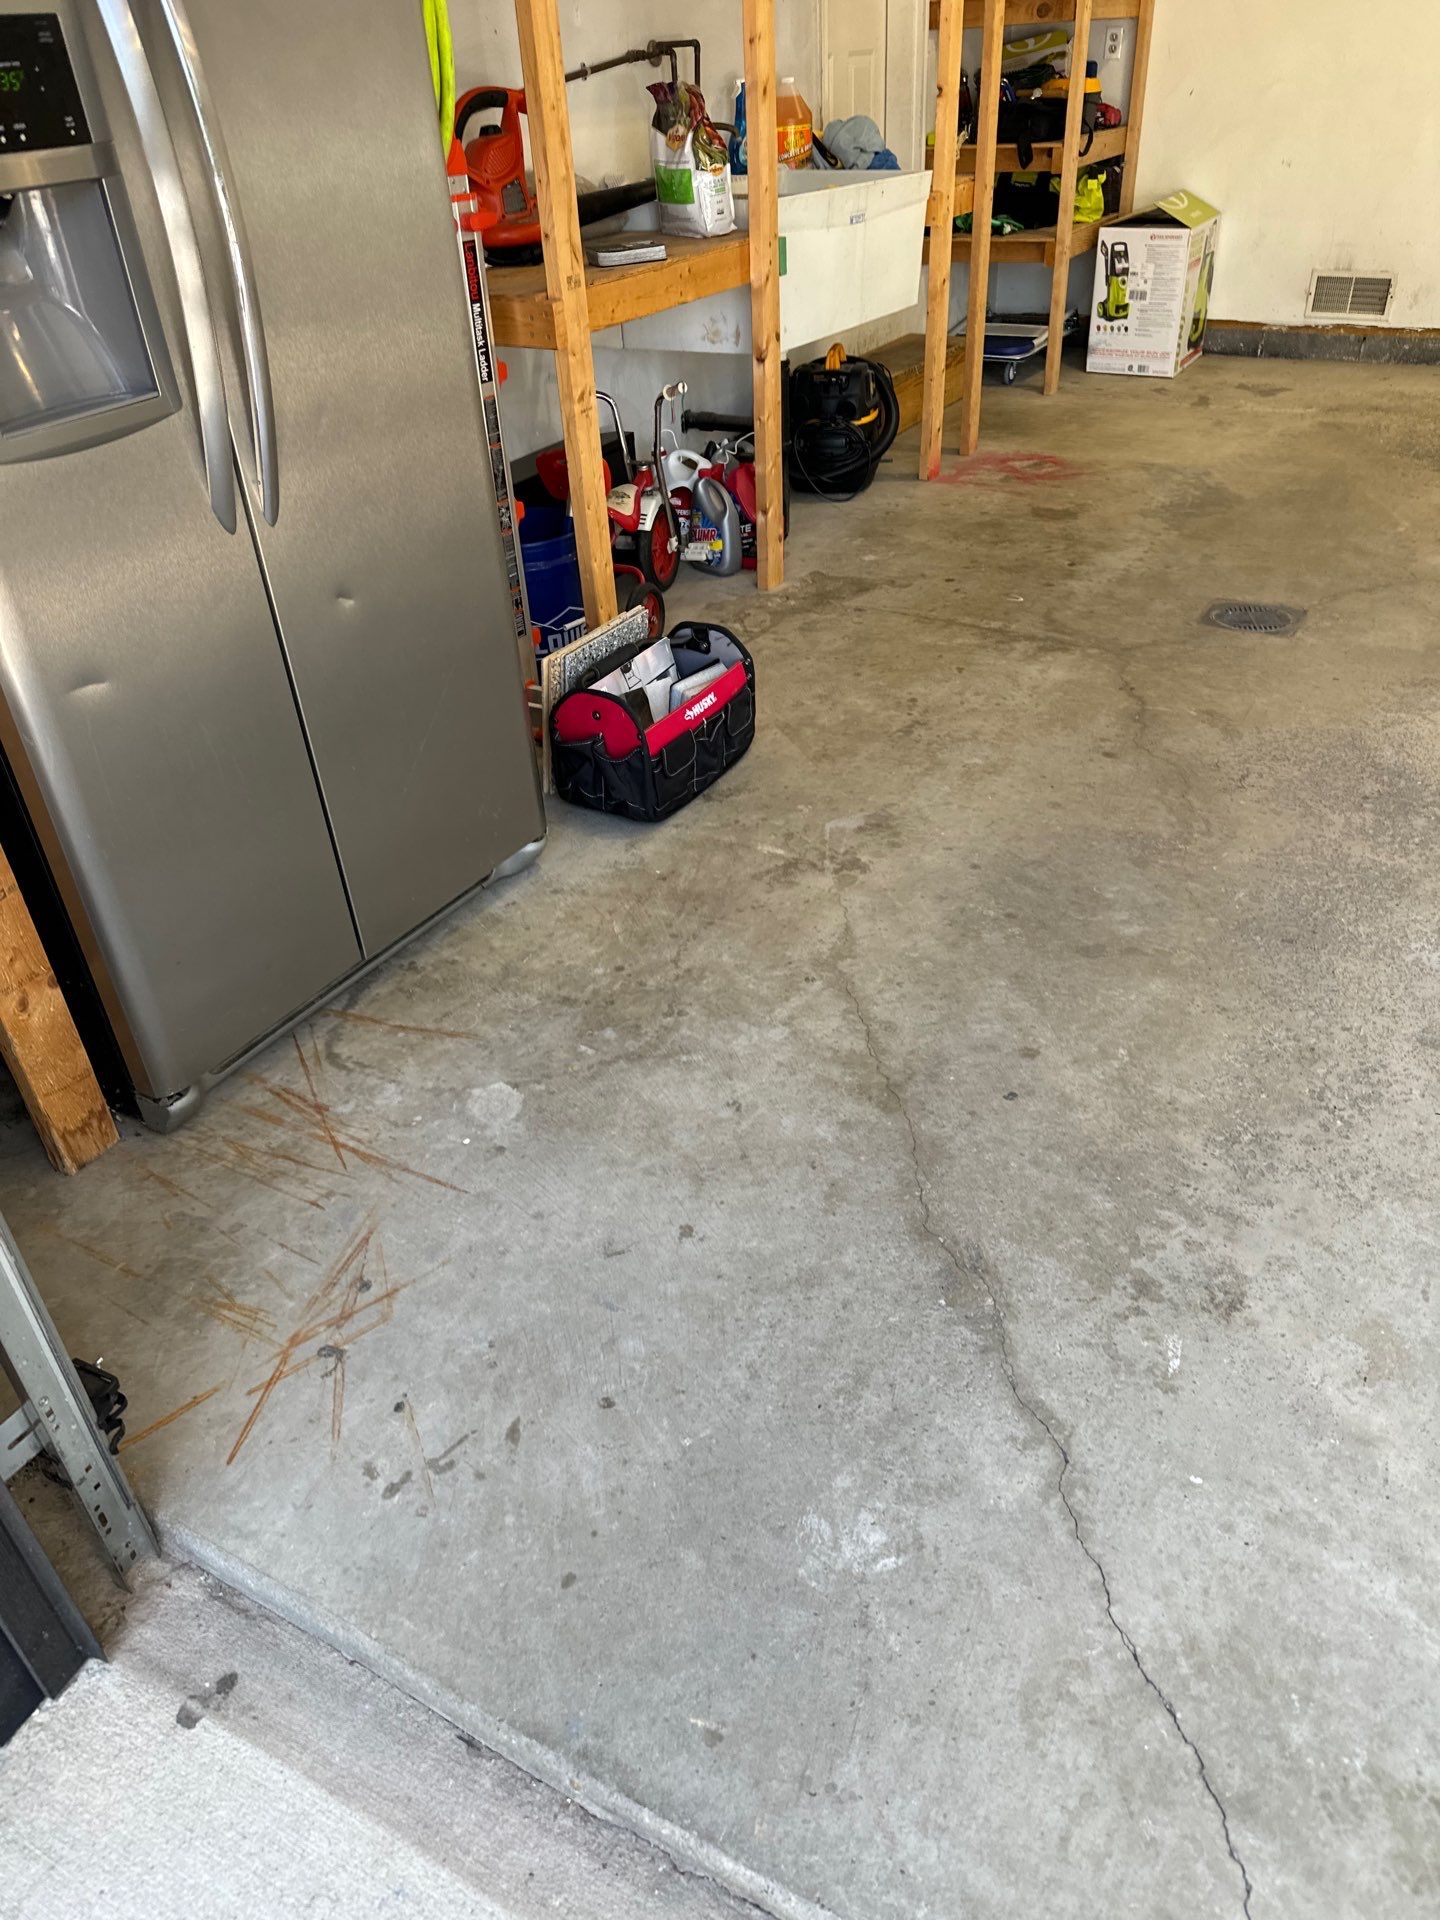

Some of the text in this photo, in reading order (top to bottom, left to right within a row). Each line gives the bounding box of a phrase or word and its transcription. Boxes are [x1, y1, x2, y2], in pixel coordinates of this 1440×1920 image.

[463, 242, 490, 382] Lanbitou Multitask Ladder
[691, 691, 715, 717] HUSKY
